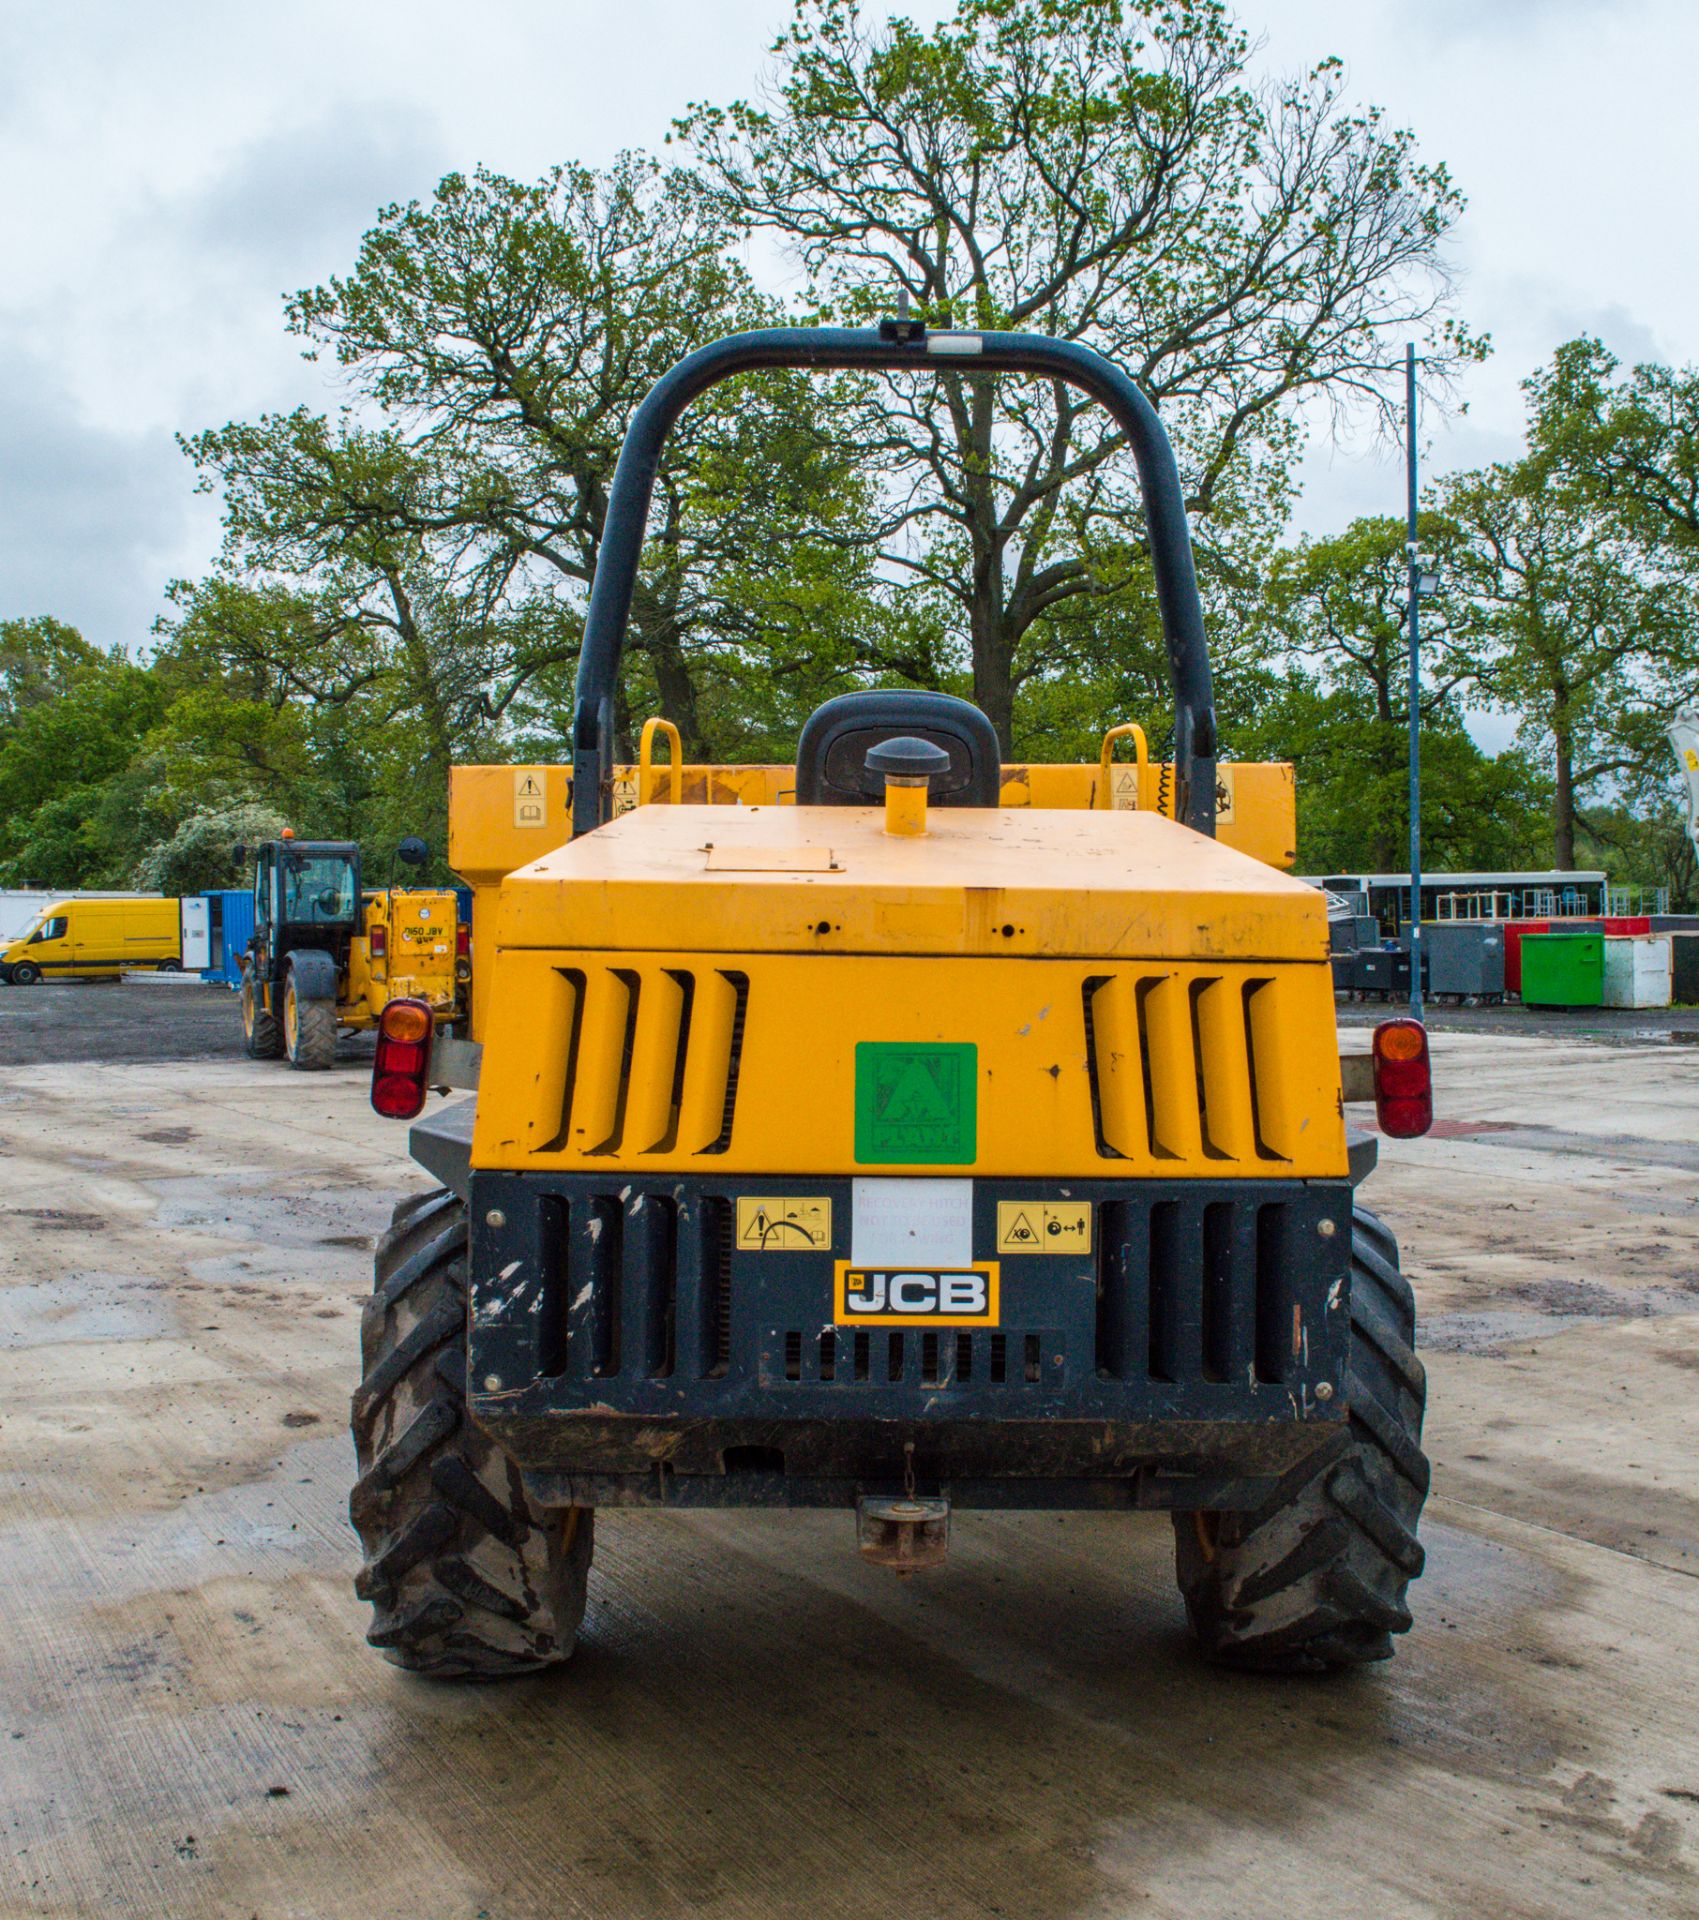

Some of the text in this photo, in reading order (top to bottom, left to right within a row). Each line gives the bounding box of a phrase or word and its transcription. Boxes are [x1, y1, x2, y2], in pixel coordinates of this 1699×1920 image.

[858, 1196, 969, 1210] RECOVERY HITCH
[859, 1215, 888, 1226] NOT
[893, 1215, 909, 1226] TO
[932, 1216, 966, 1227] USED
[848, 1274, 986, 1312] JCB
